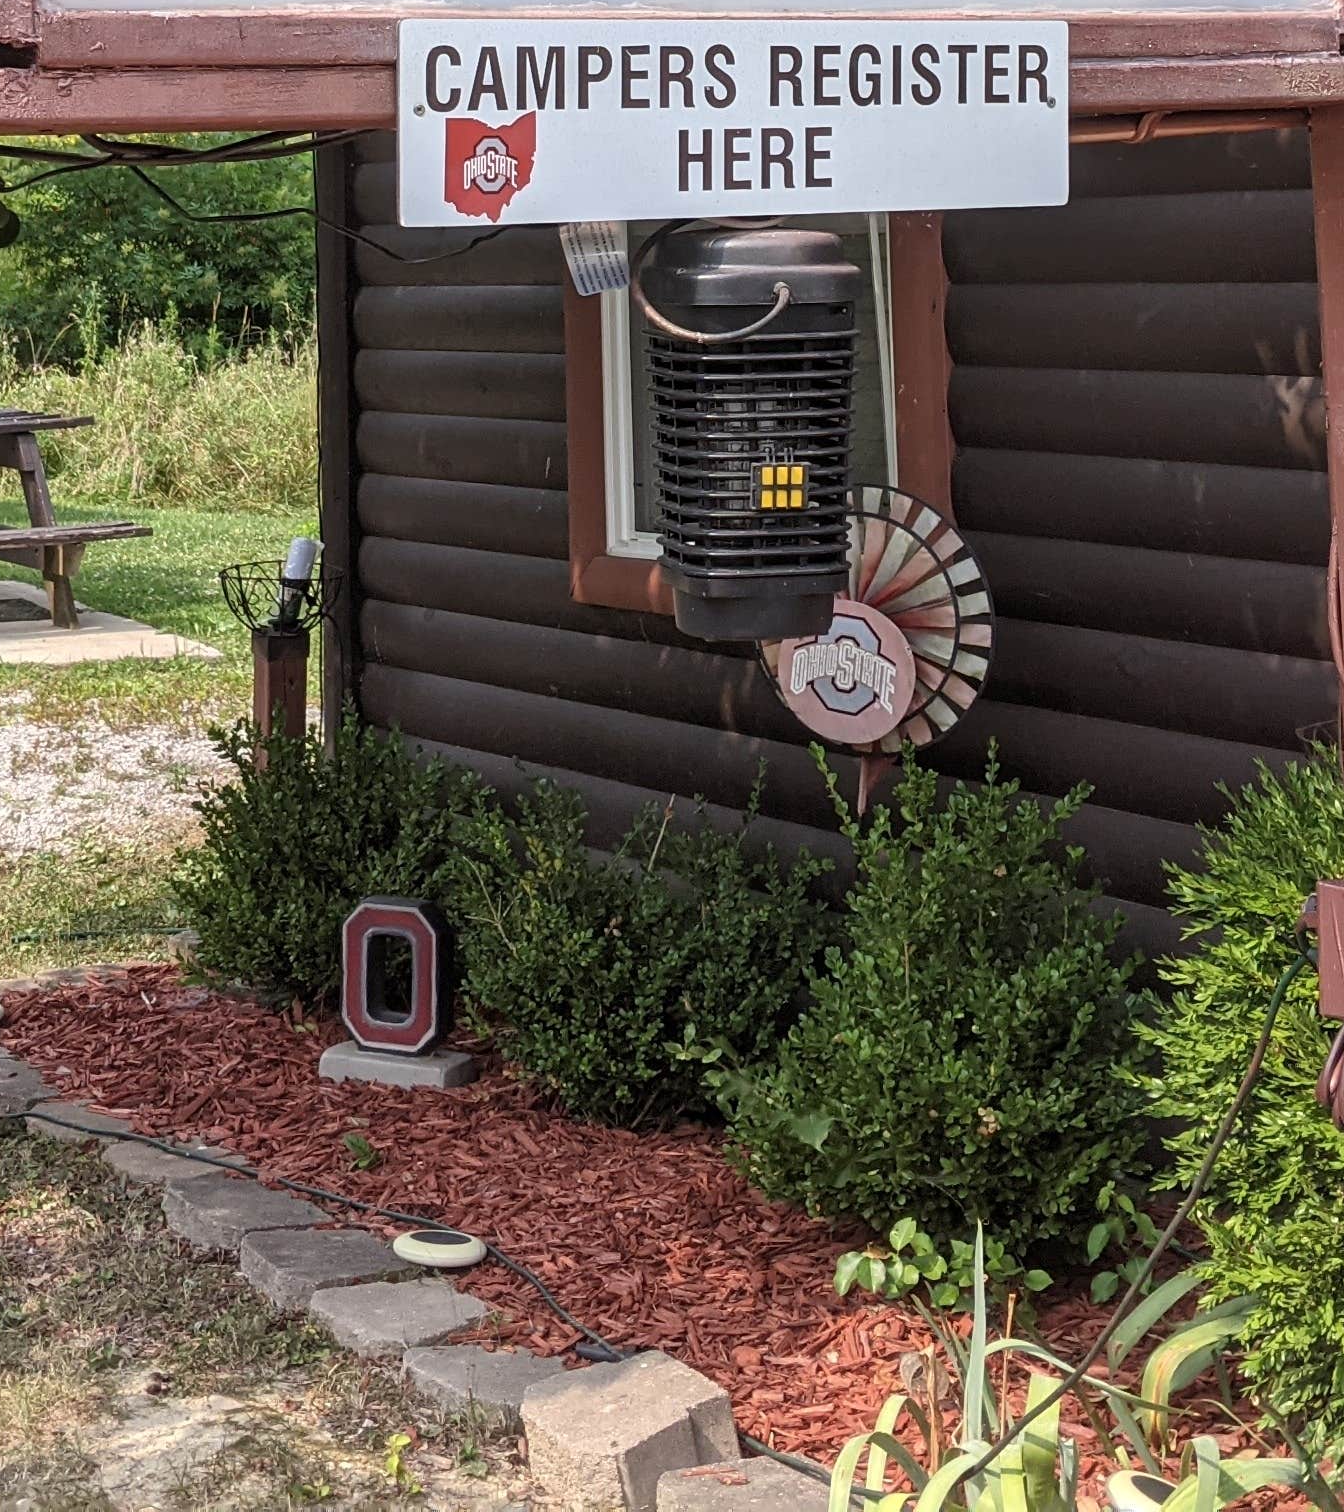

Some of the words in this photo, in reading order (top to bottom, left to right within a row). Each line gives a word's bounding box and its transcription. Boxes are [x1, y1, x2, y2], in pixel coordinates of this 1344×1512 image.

[426, 45, 736, 112] CAMPERS
[770, 44, 1055, 107] REGISTER
[679, 127, 832, 191] HERE
